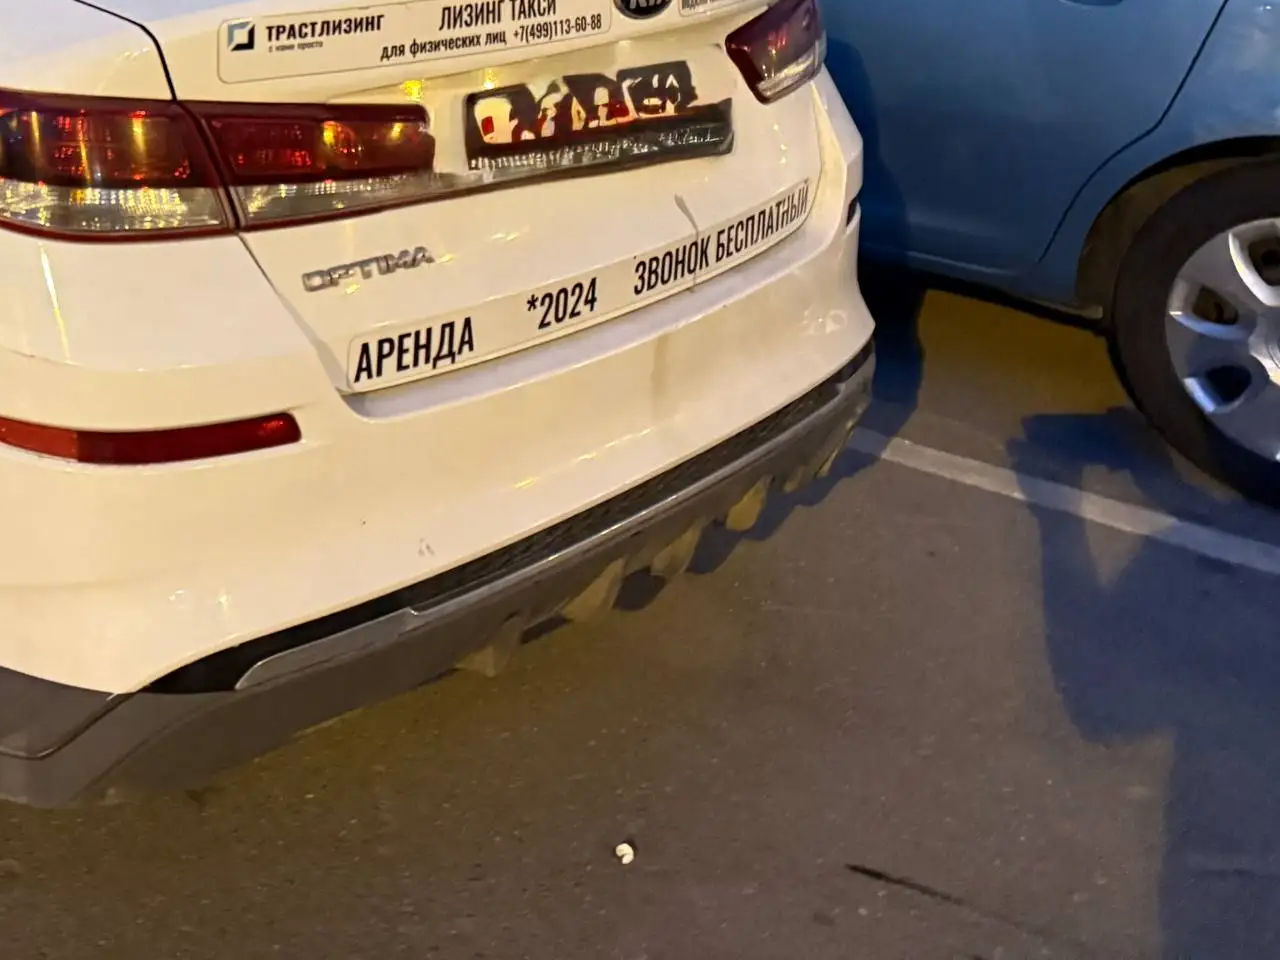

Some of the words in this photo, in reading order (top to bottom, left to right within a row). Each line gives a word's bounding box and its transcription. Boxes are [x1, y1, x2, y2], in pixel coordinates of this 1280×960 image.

[266, 14, 385, 43] ТРАСТЛИЗИНГ
[380, 44, 406, 62] для
[409, 33, 482, 59] физических
[484, 31, 507, 46] лиц
[512, 13, 602, 45] +7(499)113-60-88
[301, 245, 435, 293] OPTIMA
[353, 316, 475, 383] АРЕНДА
[633, 234, 711, 296] ЗВОНОК
[715, 182, 810, 263] БЕСПЛАТНЫЙ
